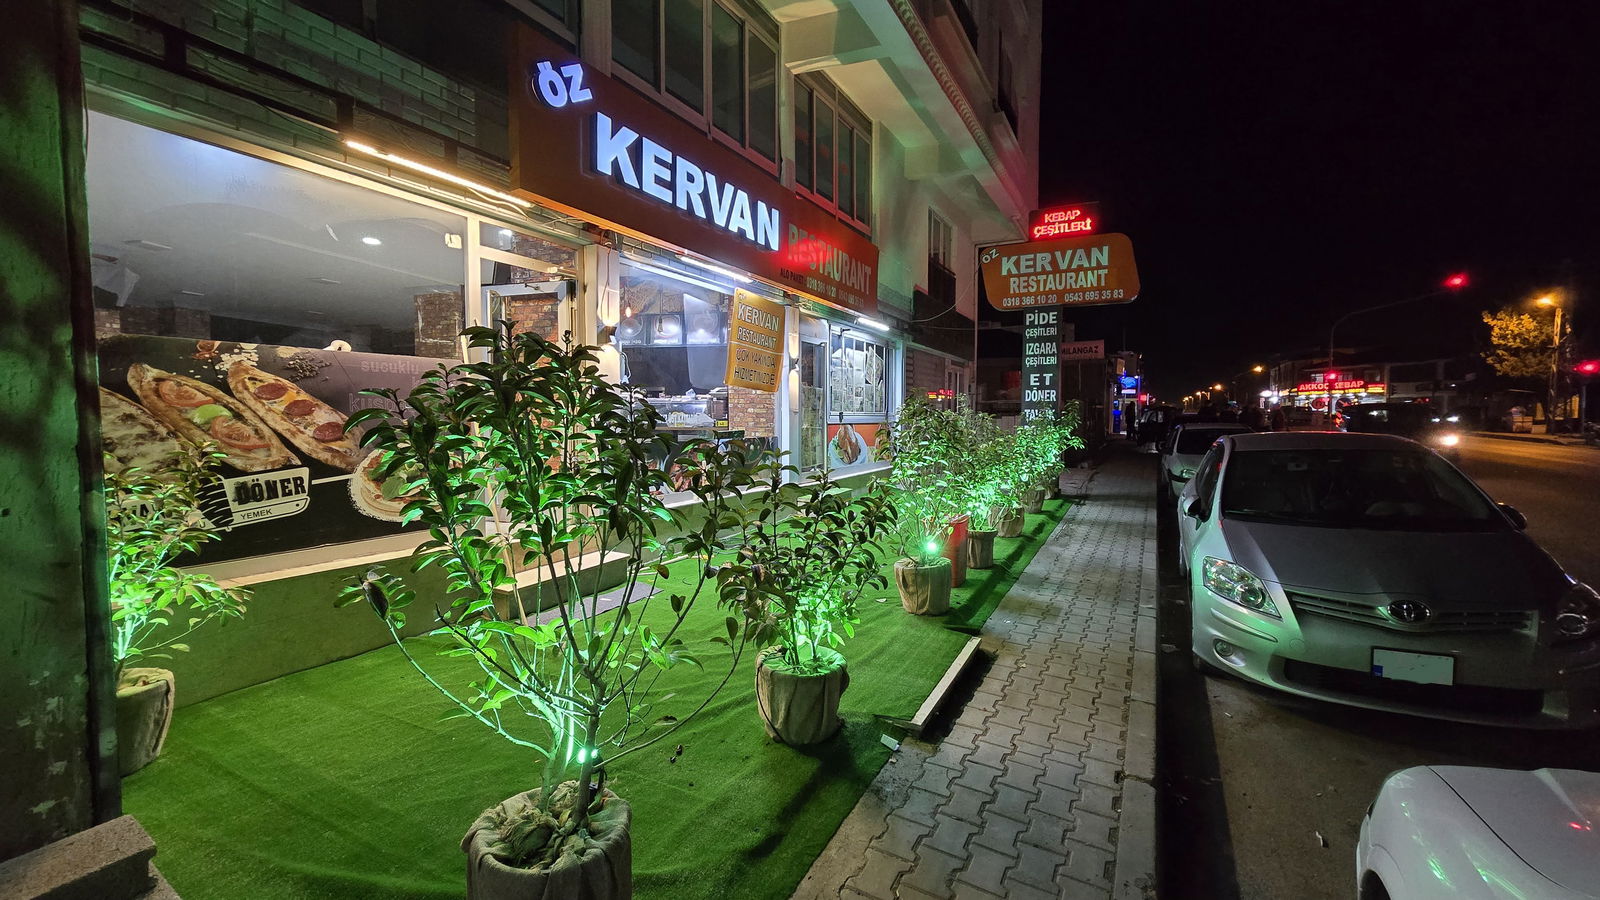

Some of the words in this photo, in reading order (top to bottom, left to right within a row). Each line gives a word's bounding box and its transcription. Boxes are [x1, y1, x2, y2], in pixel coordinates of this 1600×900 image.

[537, 61, 593, 108] ÖZ
[596, 112, 780, 252] KERVAN
[1044, 209, 1080, 223] KEBAP
[1033, 218, 1092, 238] ÇEŞİTLERİ
[788, 223, 872, 295] RESTAURANT
[981, 248, 1000, 264] ÖZ
[1000, 245, 1109, 276] KERVAN
[1009, 269, 1108, 294] RESTAURANT
[1002, 296, 1020, 307] 0318
[1021, 295, 1035, 306] 366
[1037, 294, 1046, 305] 10
[1047, 294, 1057, 304] 20
[1064, 292, 1083, 302] 0543
[1085, 290, 1100, 301] 695
[1101, 289, 1111, 300] 35
[1113, 288, 1124, 299] 83
[737, 301, 780, 332] KERVAN
[1025, 309, 1058, 326] PİDE
[736, 326, 777, 350] RESTAURANT
[1025, 327, 1058, 339] ÇEŞİTLERİ
[1025, 342, 1058, 355] IZGARA
[1025, 355, 1057, 368] ÇEŞİTLERİ
[1029, 373, 1053, 386] ET
[1025, 387, 1057, 402] DÖNER
[1024, 409, 1056, 421] TAK
[233, 476, 306, 506] DÖNER
[240, 508, 273, 520] YEMEK
